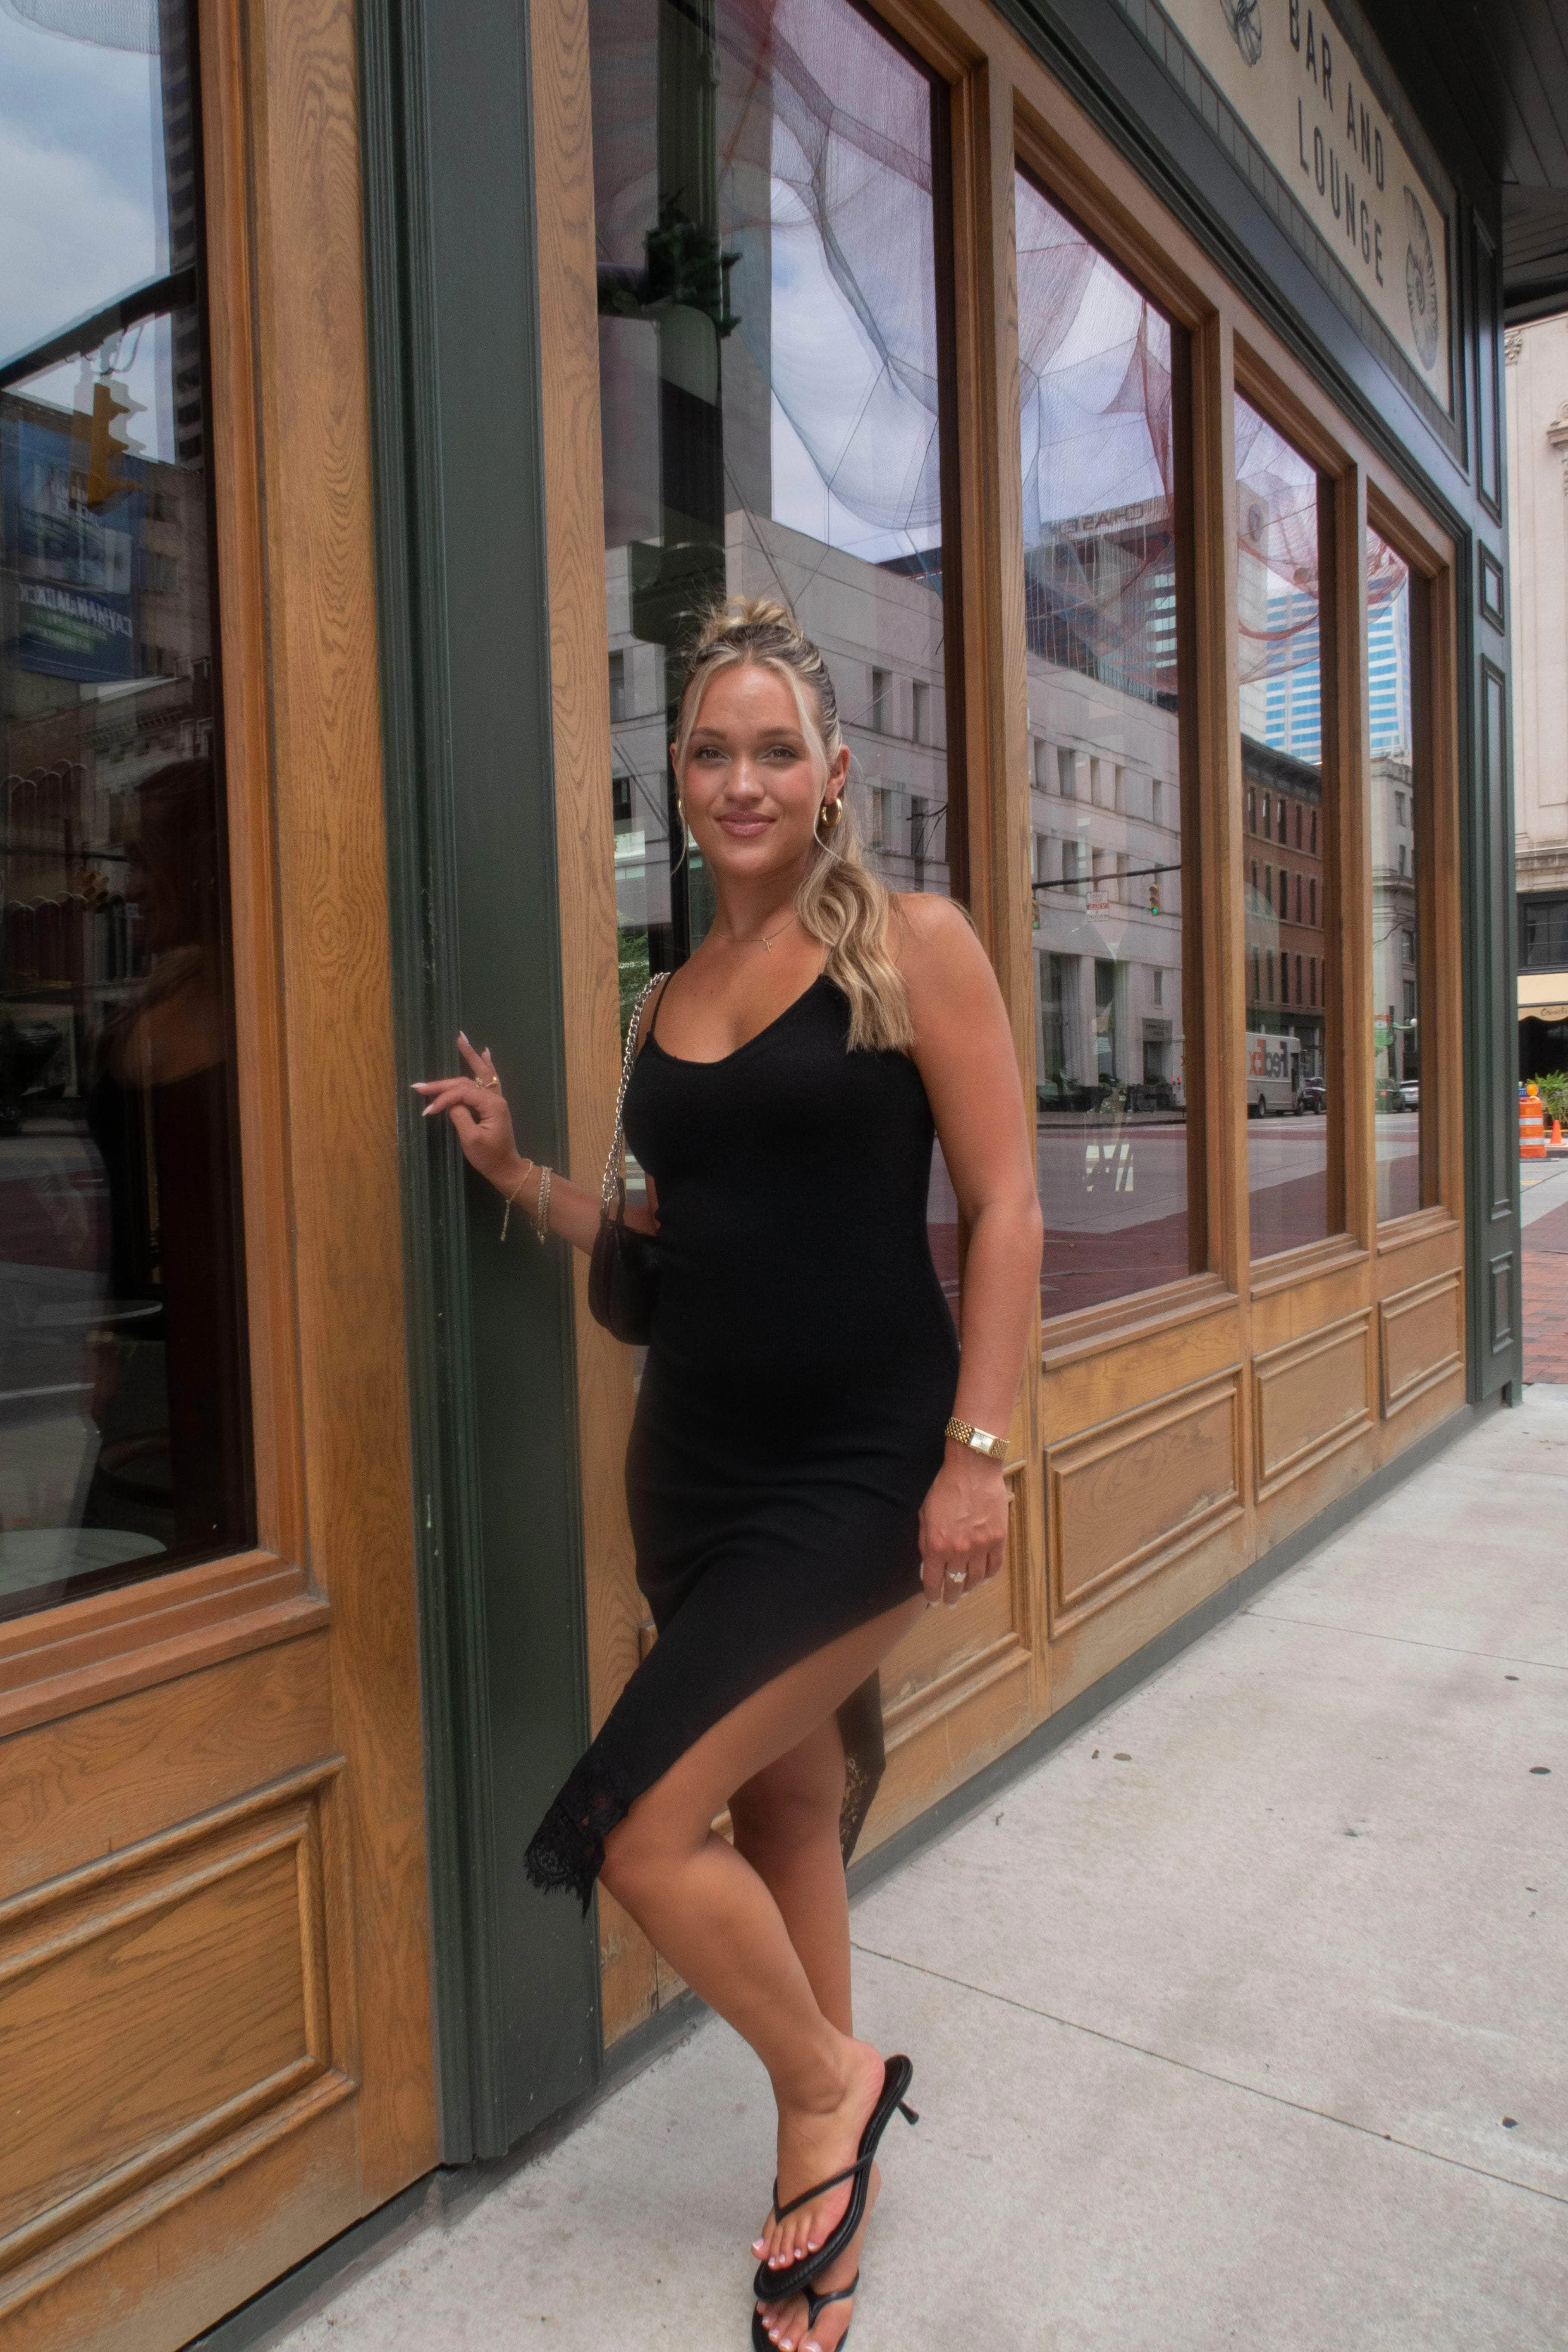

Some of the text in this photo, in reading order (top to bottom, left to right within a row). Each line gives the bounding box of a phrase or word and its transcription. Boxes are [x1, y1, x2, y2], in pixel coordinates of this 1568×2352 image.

[1290, 0, 1384, 192] BAR AND
[1298, 96, 1383, 288] LOUNGE
